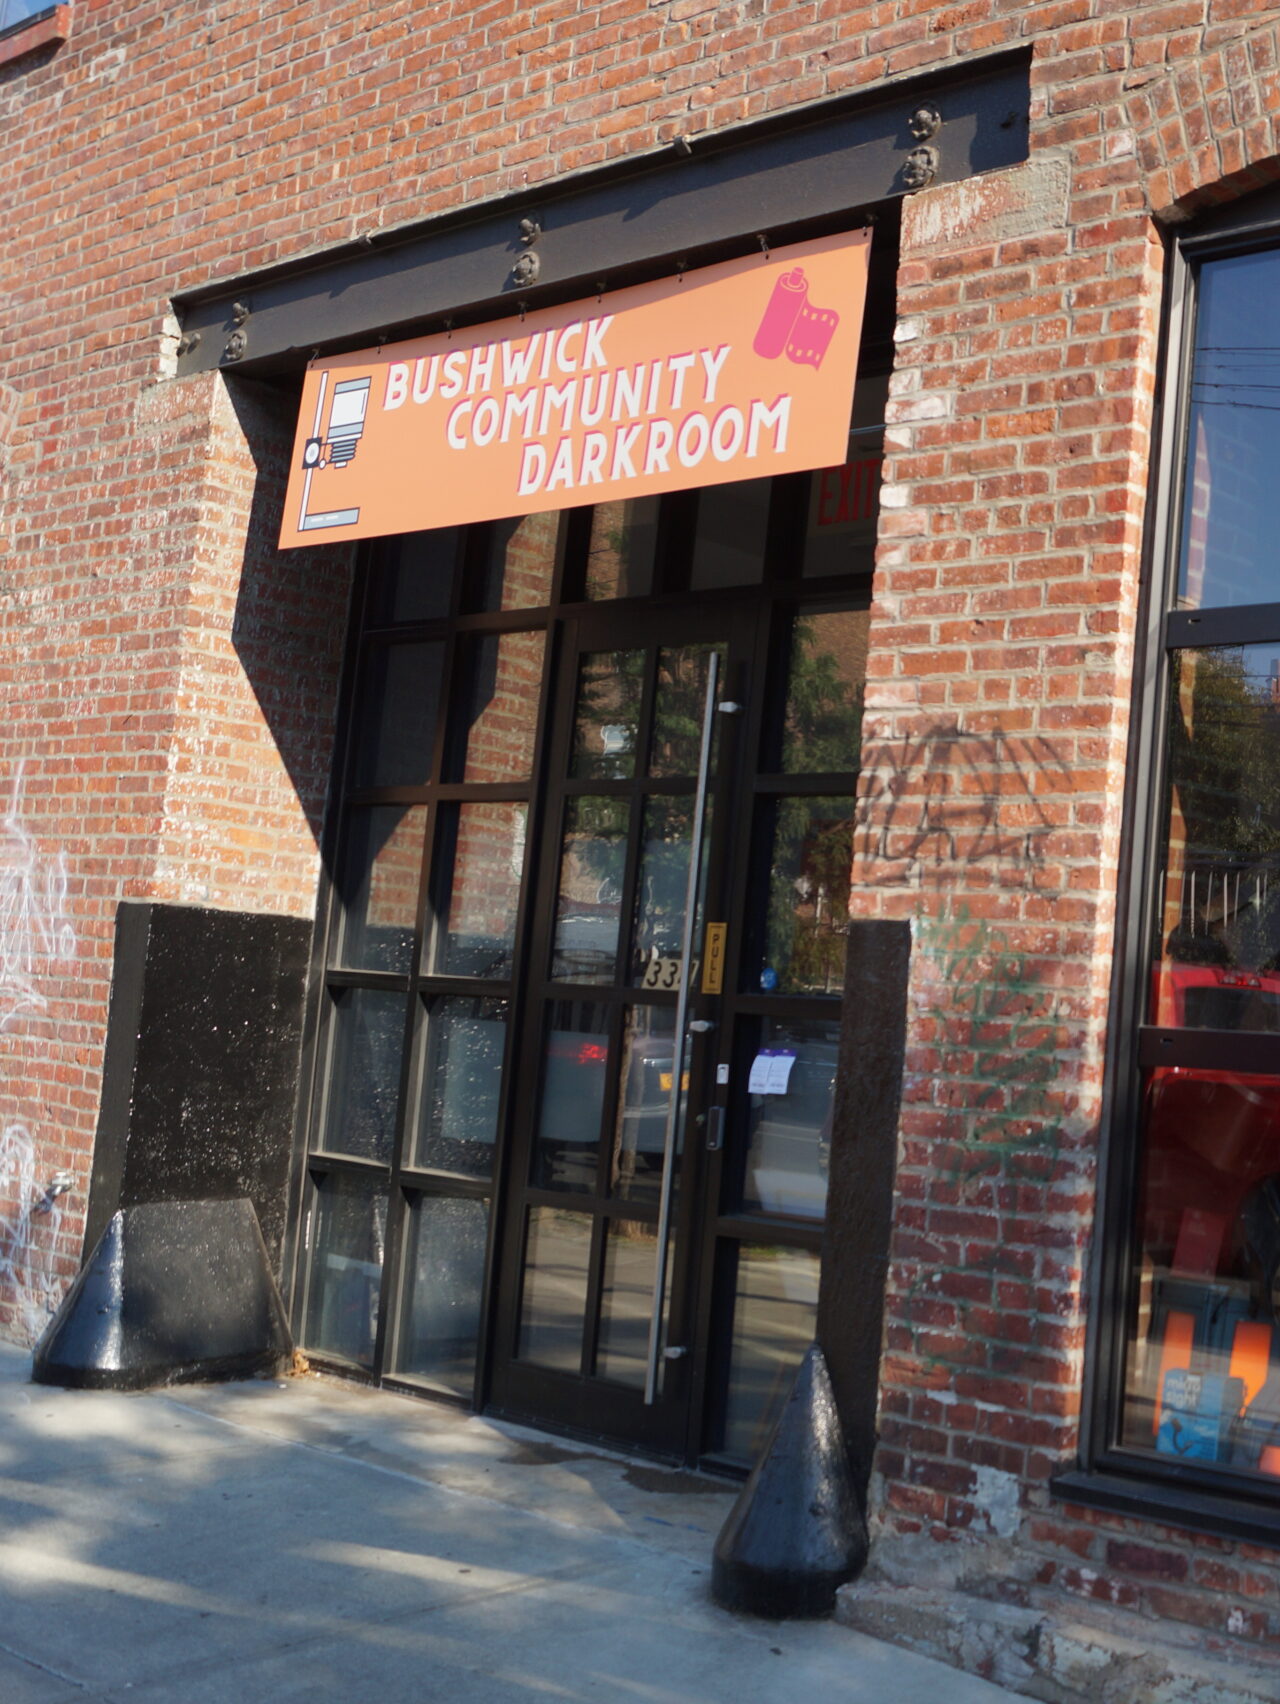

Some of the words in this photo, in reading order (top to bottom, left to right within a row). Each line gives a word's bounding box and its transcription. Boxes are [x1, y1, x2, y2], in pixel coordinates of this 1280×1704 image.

[383, 313, 615, 410] BUSHWICK
[446, 345, 731, 450] COMMUNITY
[517, 393, 792, 496] DARKROOM
[818, 458, 881, 526] EXIT
[708, 933, 721, 985] PULL
